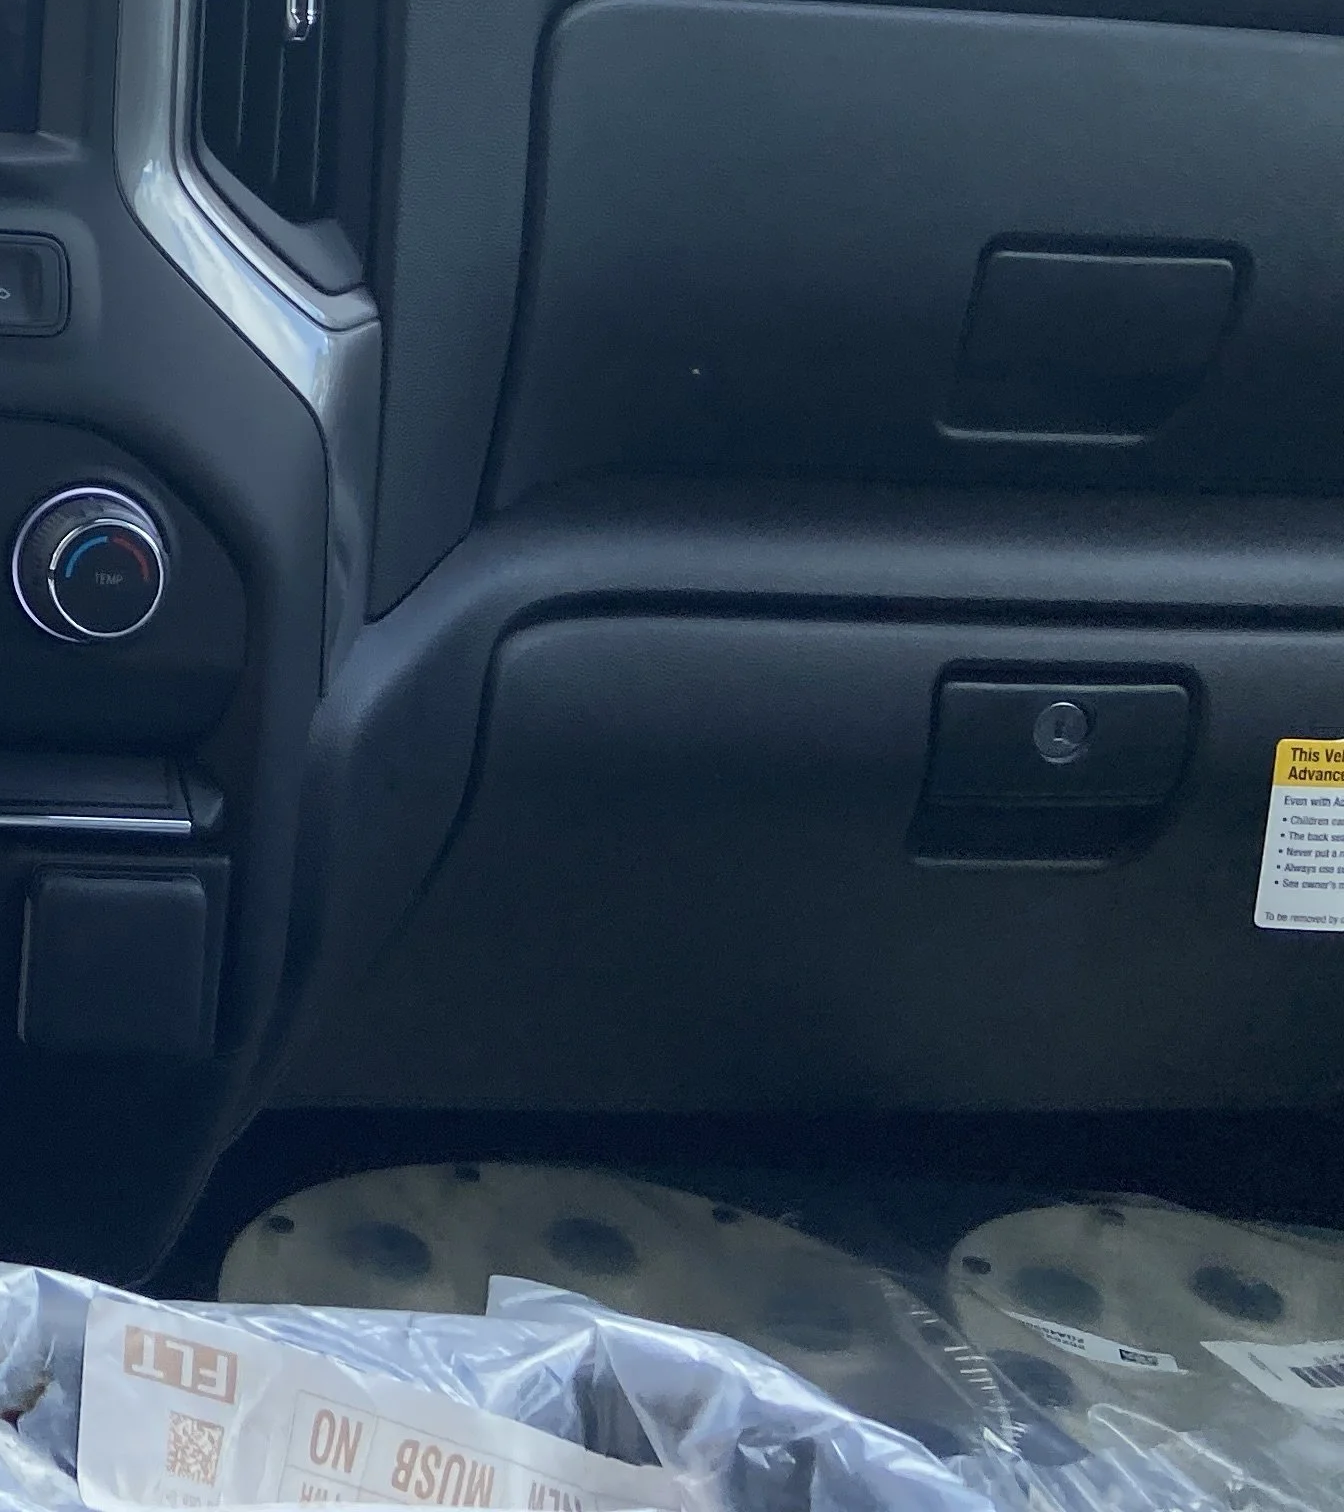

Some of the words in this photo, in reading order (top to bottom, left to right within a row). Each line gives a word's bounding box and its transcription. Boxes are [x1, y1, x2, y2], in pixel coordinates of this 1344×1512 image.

[1291, 747, 1320, 762] This
[1325, 749, 1344, 763] Ve
[1284, 795, 1308, 806] Even
[1311, 797, 1331, 807] with
[1290, 816, 1329, 826] Children
[1289, 831, 1305, 841] The
[1286, 847, 1312, 856] Never
[1315, 849, 1329, 858] put
[1283, 863, 1316, 874] Always
[1282, 879, 1299, 888] See
[1265, 911, 1274, 921] To
[1277, 913, 1288, 922] be
[1328, 915, 1338, 925] by
[131, 1334, 228, 1397] FLT
[310, 1408, 363, 1474] NO
[391, 1439, 495, 1508] MUSB
